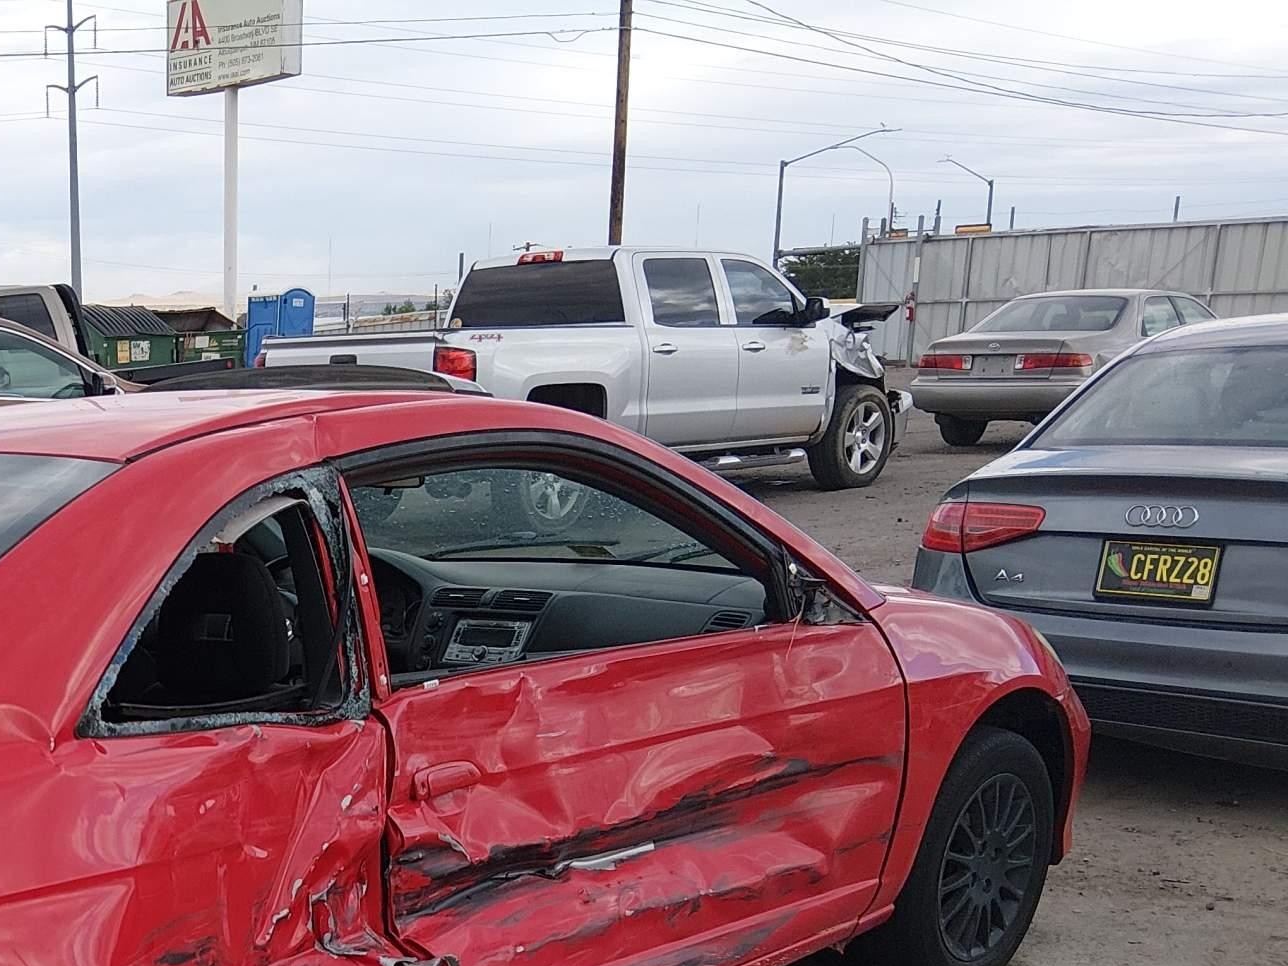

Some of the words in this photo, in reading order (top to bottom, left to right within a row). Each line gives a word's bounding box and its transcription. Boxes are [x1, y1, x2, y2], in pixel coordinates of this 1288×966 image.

[256, 13, 280, 23] Auctions
[169, 54, 212, 72] INSURANCE
[169, 75, 185, 88] AUTO
[185, 70, 212, 84] AUCTIONS
[994, 568, 1024, 582] A4
[1130, 553, 1212, 585] CFRZ28
